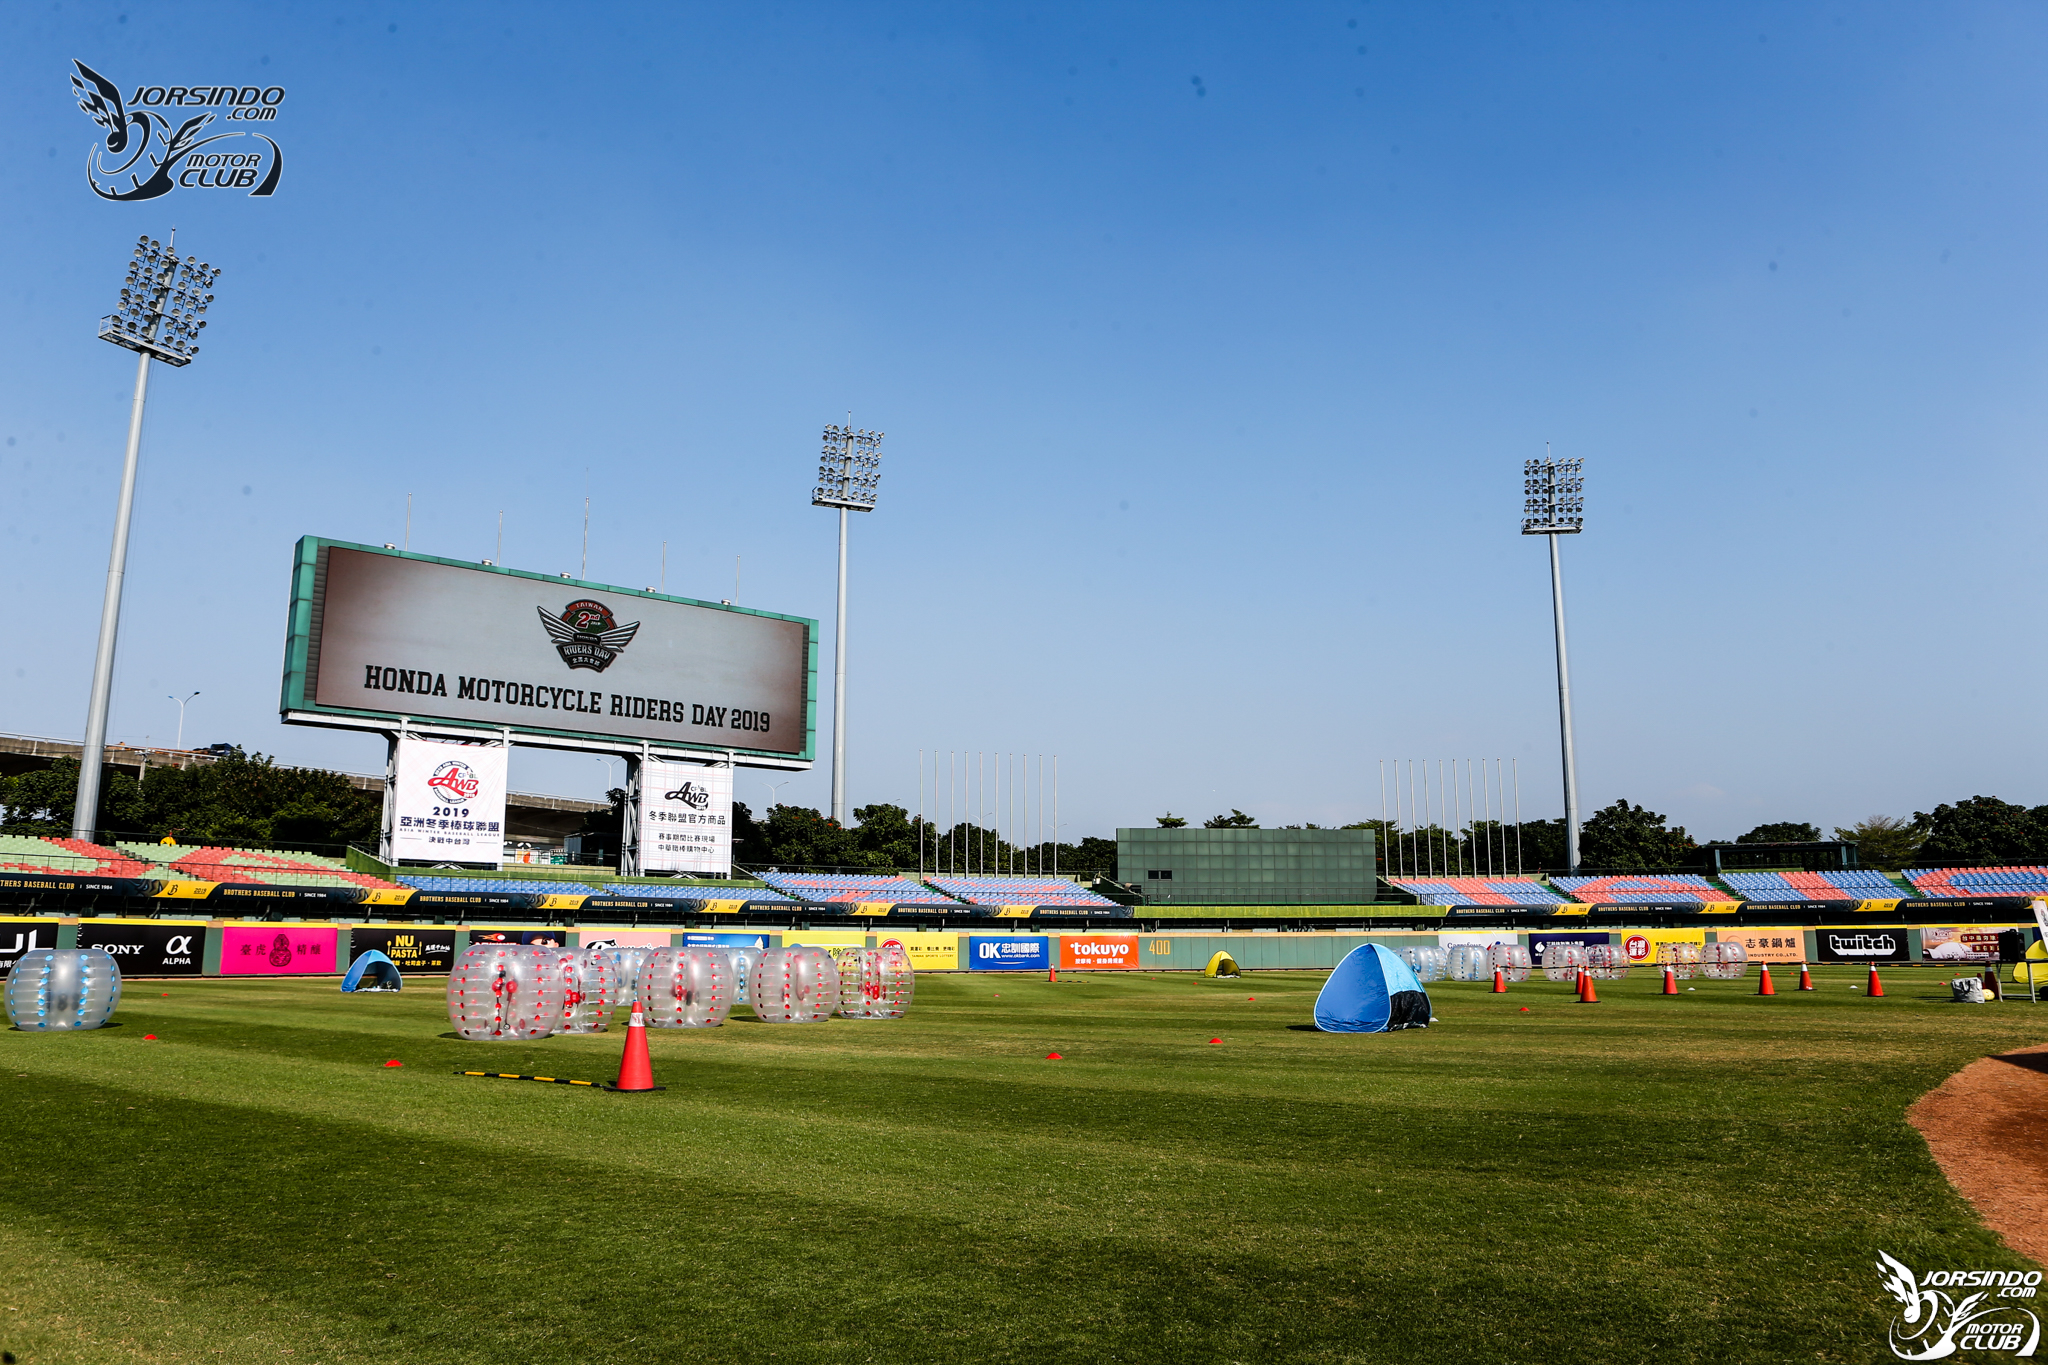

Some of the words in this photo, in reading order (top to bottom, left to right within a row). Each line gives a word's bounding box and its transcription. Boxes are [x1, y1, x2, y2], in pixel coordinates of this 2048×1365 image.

[575, 602, 604, 612] TAIWAN
[562, 644, 592, 656] RIDERS
[594, 646, 611, 660] DAY
[364, 664, 448, 697] HONDA
[457, 676, 602, 714] MOTORCYCLE
[609, 694, 684, 723] RIDERS
[691, 703, 727, 728] DAY
[731, 708, 770, 733] 2019
[433, 806, 470, 817] 2019
[649, 810, 726, 825] 冬季聯盟官方商品
[400, 816, 500, 832] 亞洲冬季棒球聯盟
[428, 836, 470, 845] 決戰中台灣
[23, 881, 56, 889] BASEBALL
[58, 882, 75, 890] CLUB
[223, 888, 252, 896] BROTHERS
[253, 889, 280, 897] BASEBALL
[281, 889, 296, 898] CLUB
[395, 935, 414, 947] NU
[1148, 939, 1171, 955] 400
[1829, 934, 1896, 956] twitch
[91, 943, 144, 955] SONY
[390, 949, 418, 958] PASTA
[979, 942, 1001, 959] OK
[1001, 943, 1040, 953] 忠訓國際
[1071, 942, 1129, 957] tokuyo
[162, 957, 191, 965] ALPHA
